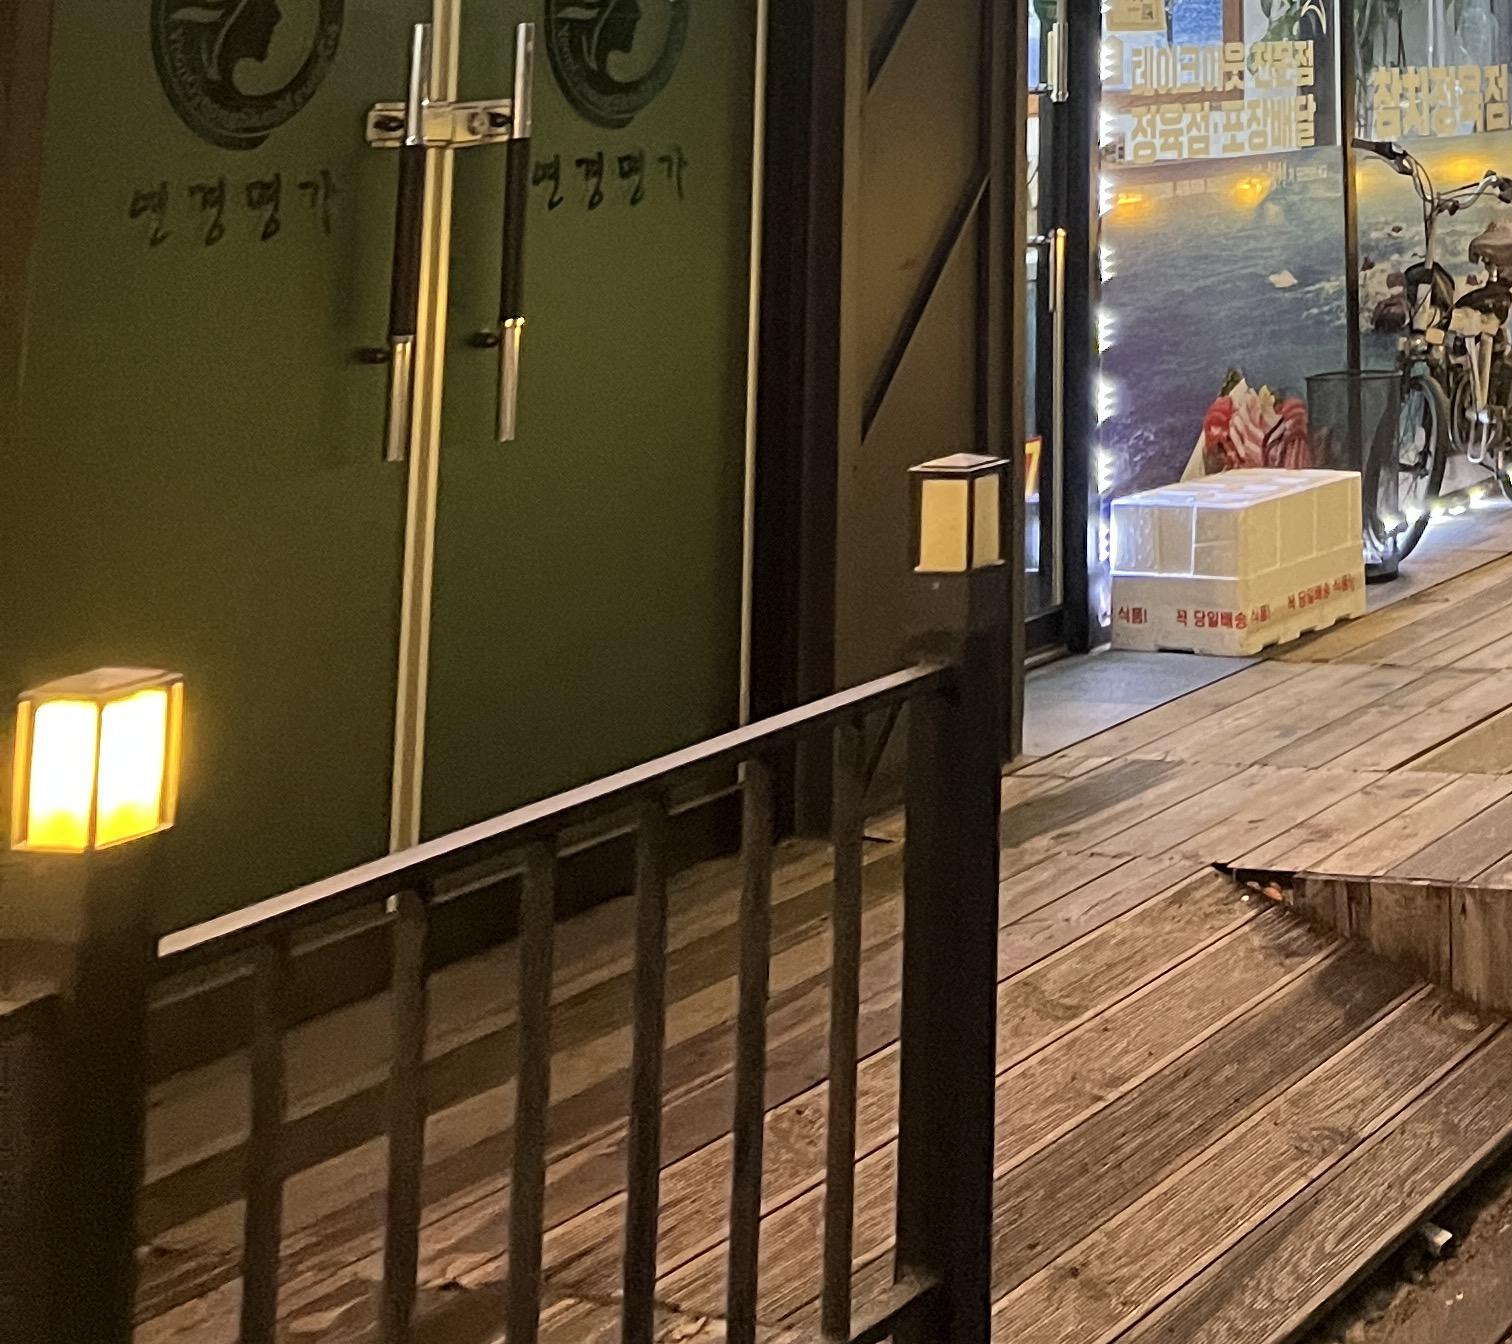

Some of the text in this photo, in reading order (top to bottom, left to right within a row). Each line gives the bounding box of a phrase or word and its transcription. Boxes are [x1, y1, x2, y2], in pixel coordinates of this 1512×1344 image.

[1131, 40, 1315, 96] 테이크아웃 전문점
[1371, 63, 1509, 139] 참치정육점
[128, 169, 339, 249] 연경명가
[531, 146, 689, 211] 연경명가
[1193, 609, 1248, 630] 당일배송
